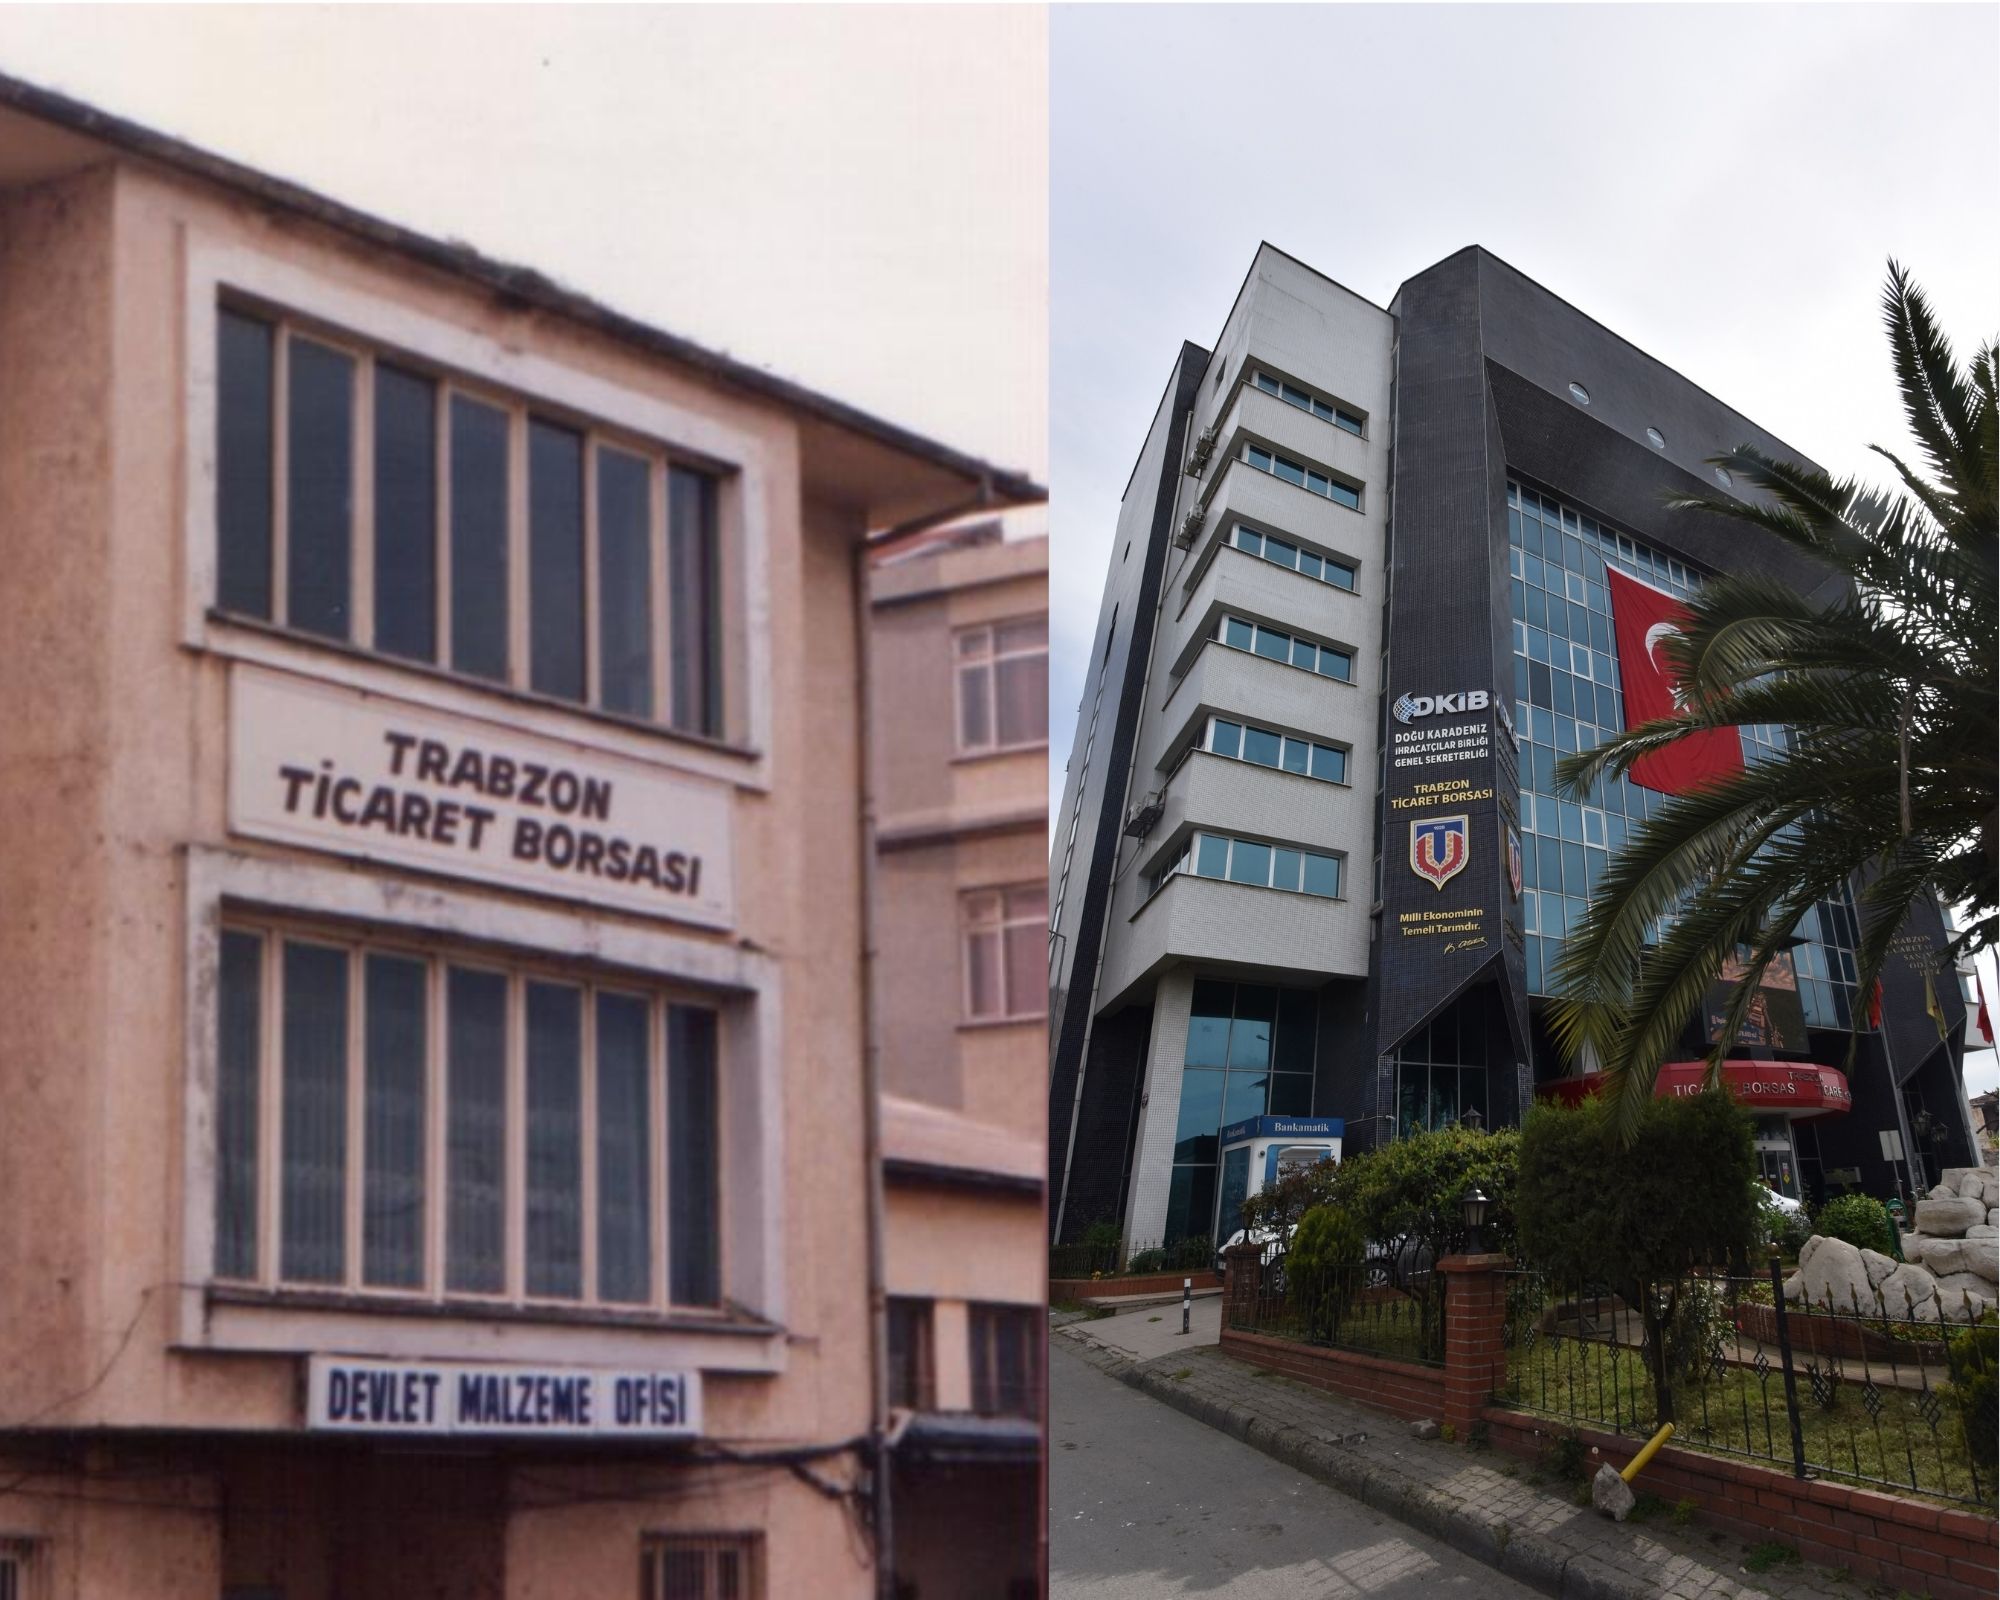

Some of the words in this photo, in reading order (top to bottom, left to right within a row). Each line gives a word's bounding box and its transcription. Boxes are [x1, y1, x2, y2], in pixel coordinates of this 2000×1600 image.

[1395, 731, 1424, 743] DOĞU
[1427, 723, 1487, 739] KARADENİZ
[1394, 756, 1423, 768] GENEL
[385, 730, 613, 821] TRABZON
[1414, 779, 1470, 794] TRABZON
[1391, 794, 1440, 809] TİCARET
[1442, 788, 1493, 804] BORSASI
[278, 760, 495, 851] TİCARET
[511, 818, 702, 897] BORSASI
[1423, 908, 1484, 921] Ekonominin
[1274, 1122, 1329, 1132] Bankamatik
[327, 1368, 440, 1423] DEVLET
[458, 1373, 591, 1426] MALZEME
[615, 1373, 686, 1426] OFİSİ
